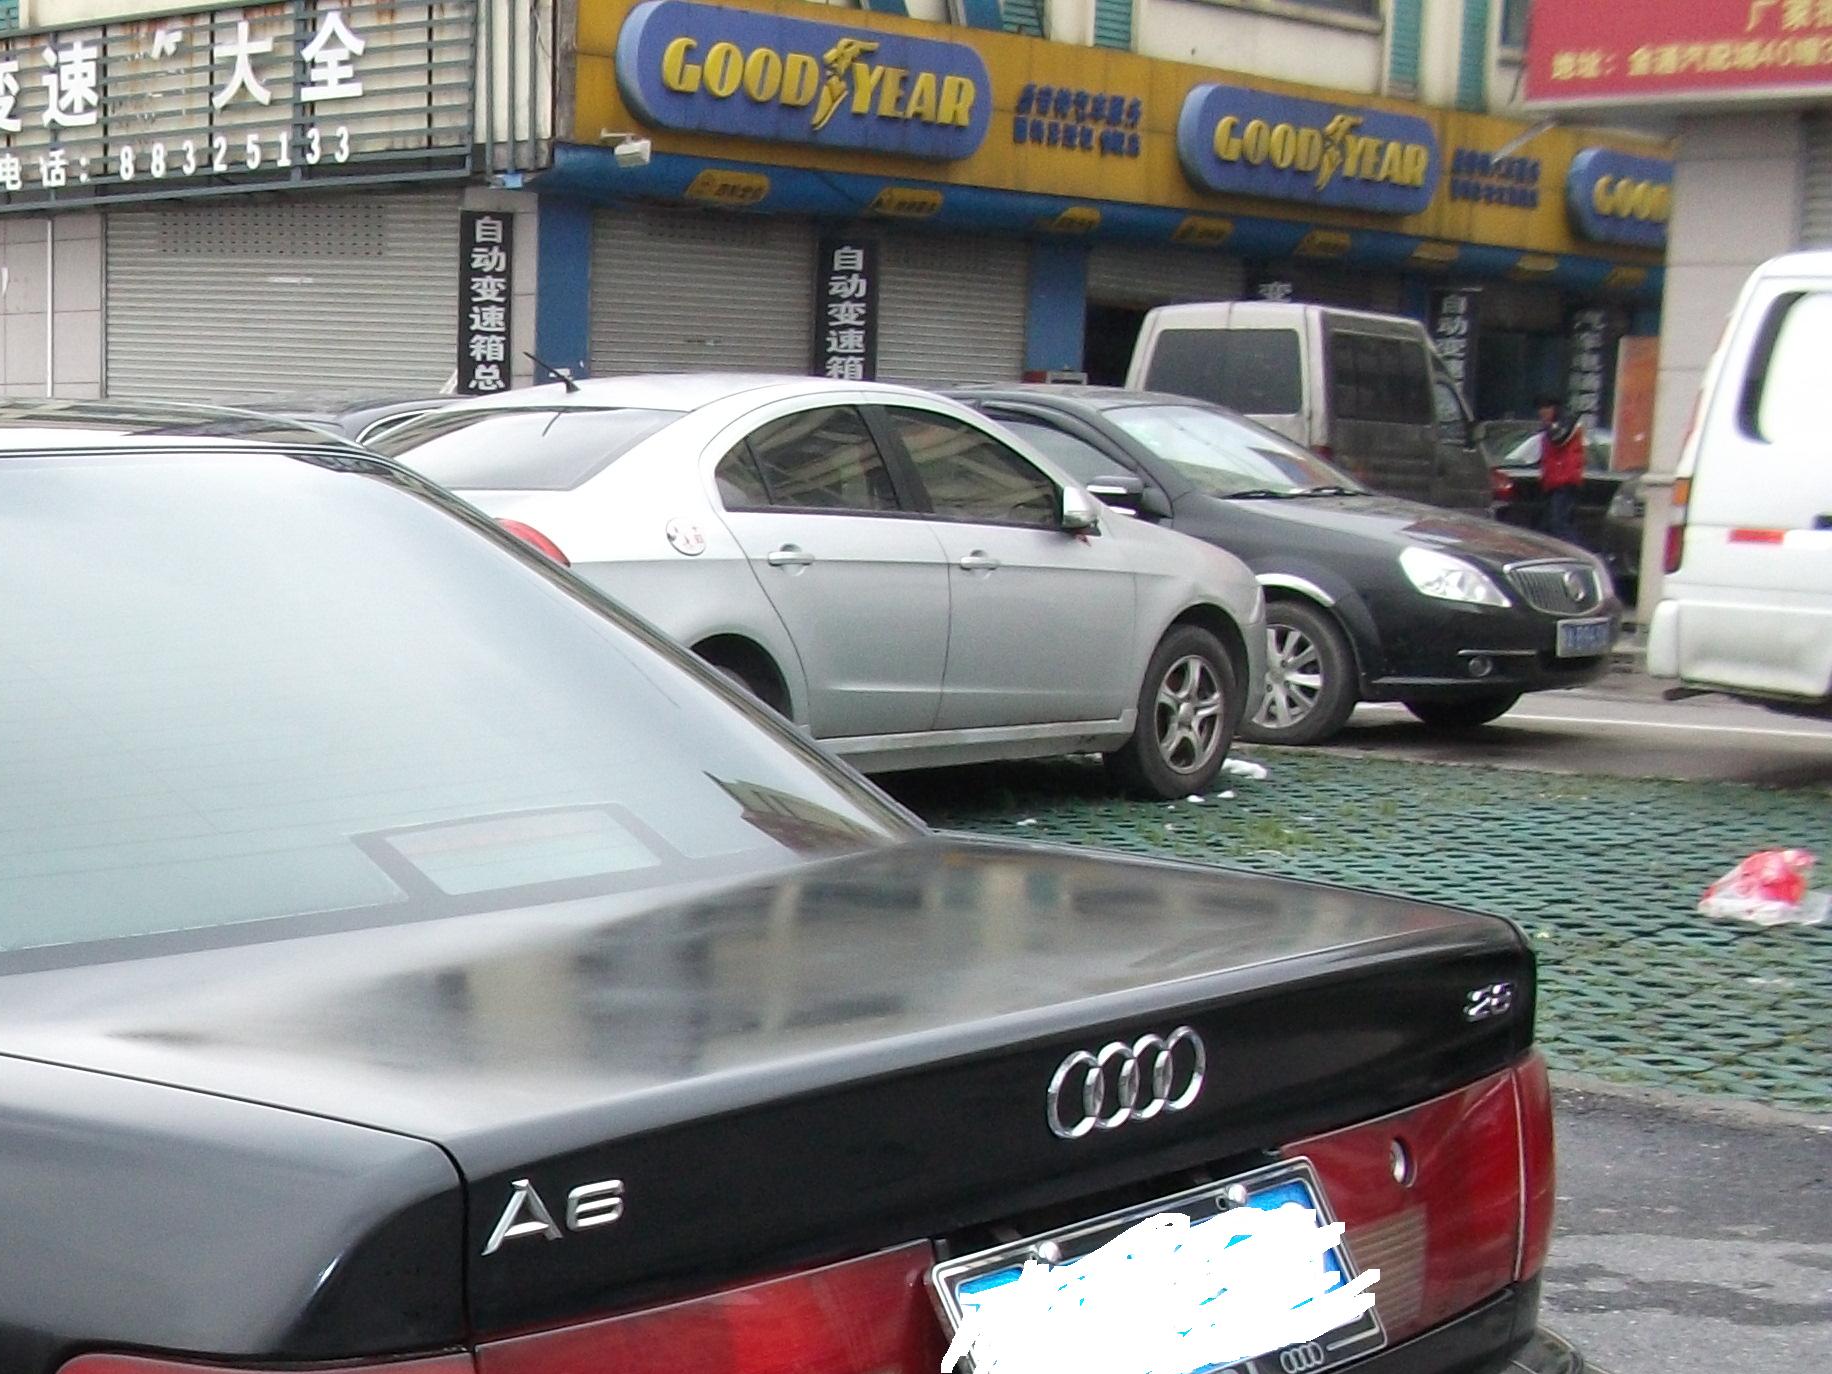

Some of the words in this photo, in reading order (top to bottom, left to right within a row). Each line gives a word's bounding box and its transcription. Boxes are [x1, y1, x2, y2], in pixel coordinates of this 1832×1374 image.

[661, 36, 977, 130] GOODYEAR
[1213, 114, 1429, 191] GOODYEAR
[468, 215, 507, 391] 自动变速箱总
[825, 245, 868, 380] 自动变速箱
[481, 1178, 624, 1257] A6
